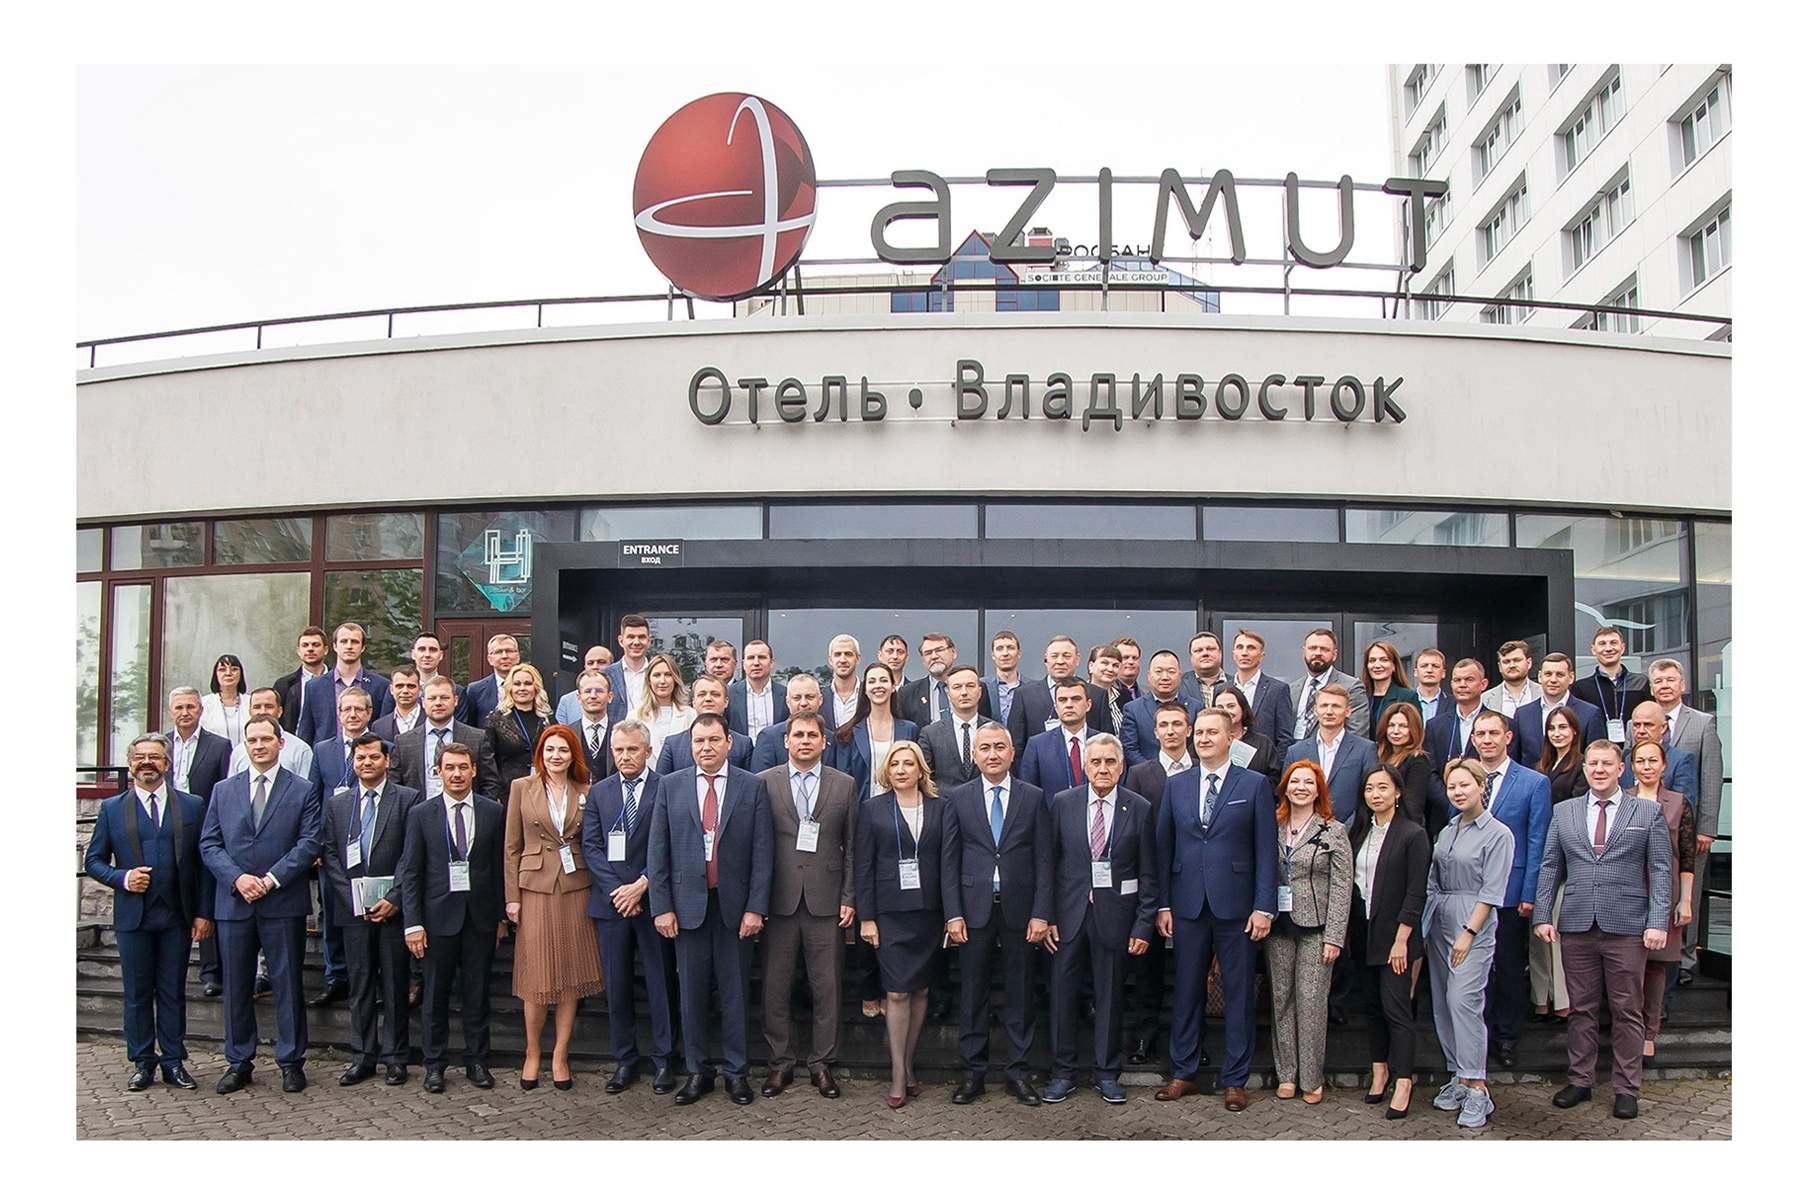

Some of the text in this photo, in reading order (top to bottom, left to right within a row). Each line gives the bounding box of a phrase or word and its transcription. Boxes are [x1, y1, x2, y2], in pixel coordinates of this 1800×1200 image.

[1058, 244, 1151, 256] РОСБАН
[1074, 273, 1127, 282] GENEALE
[1131, 273, 1168, 282] GROUP
[688, 359, 1407, 432] Отель Владивосток
[623, 545, 679, 554] ENTRANCE
